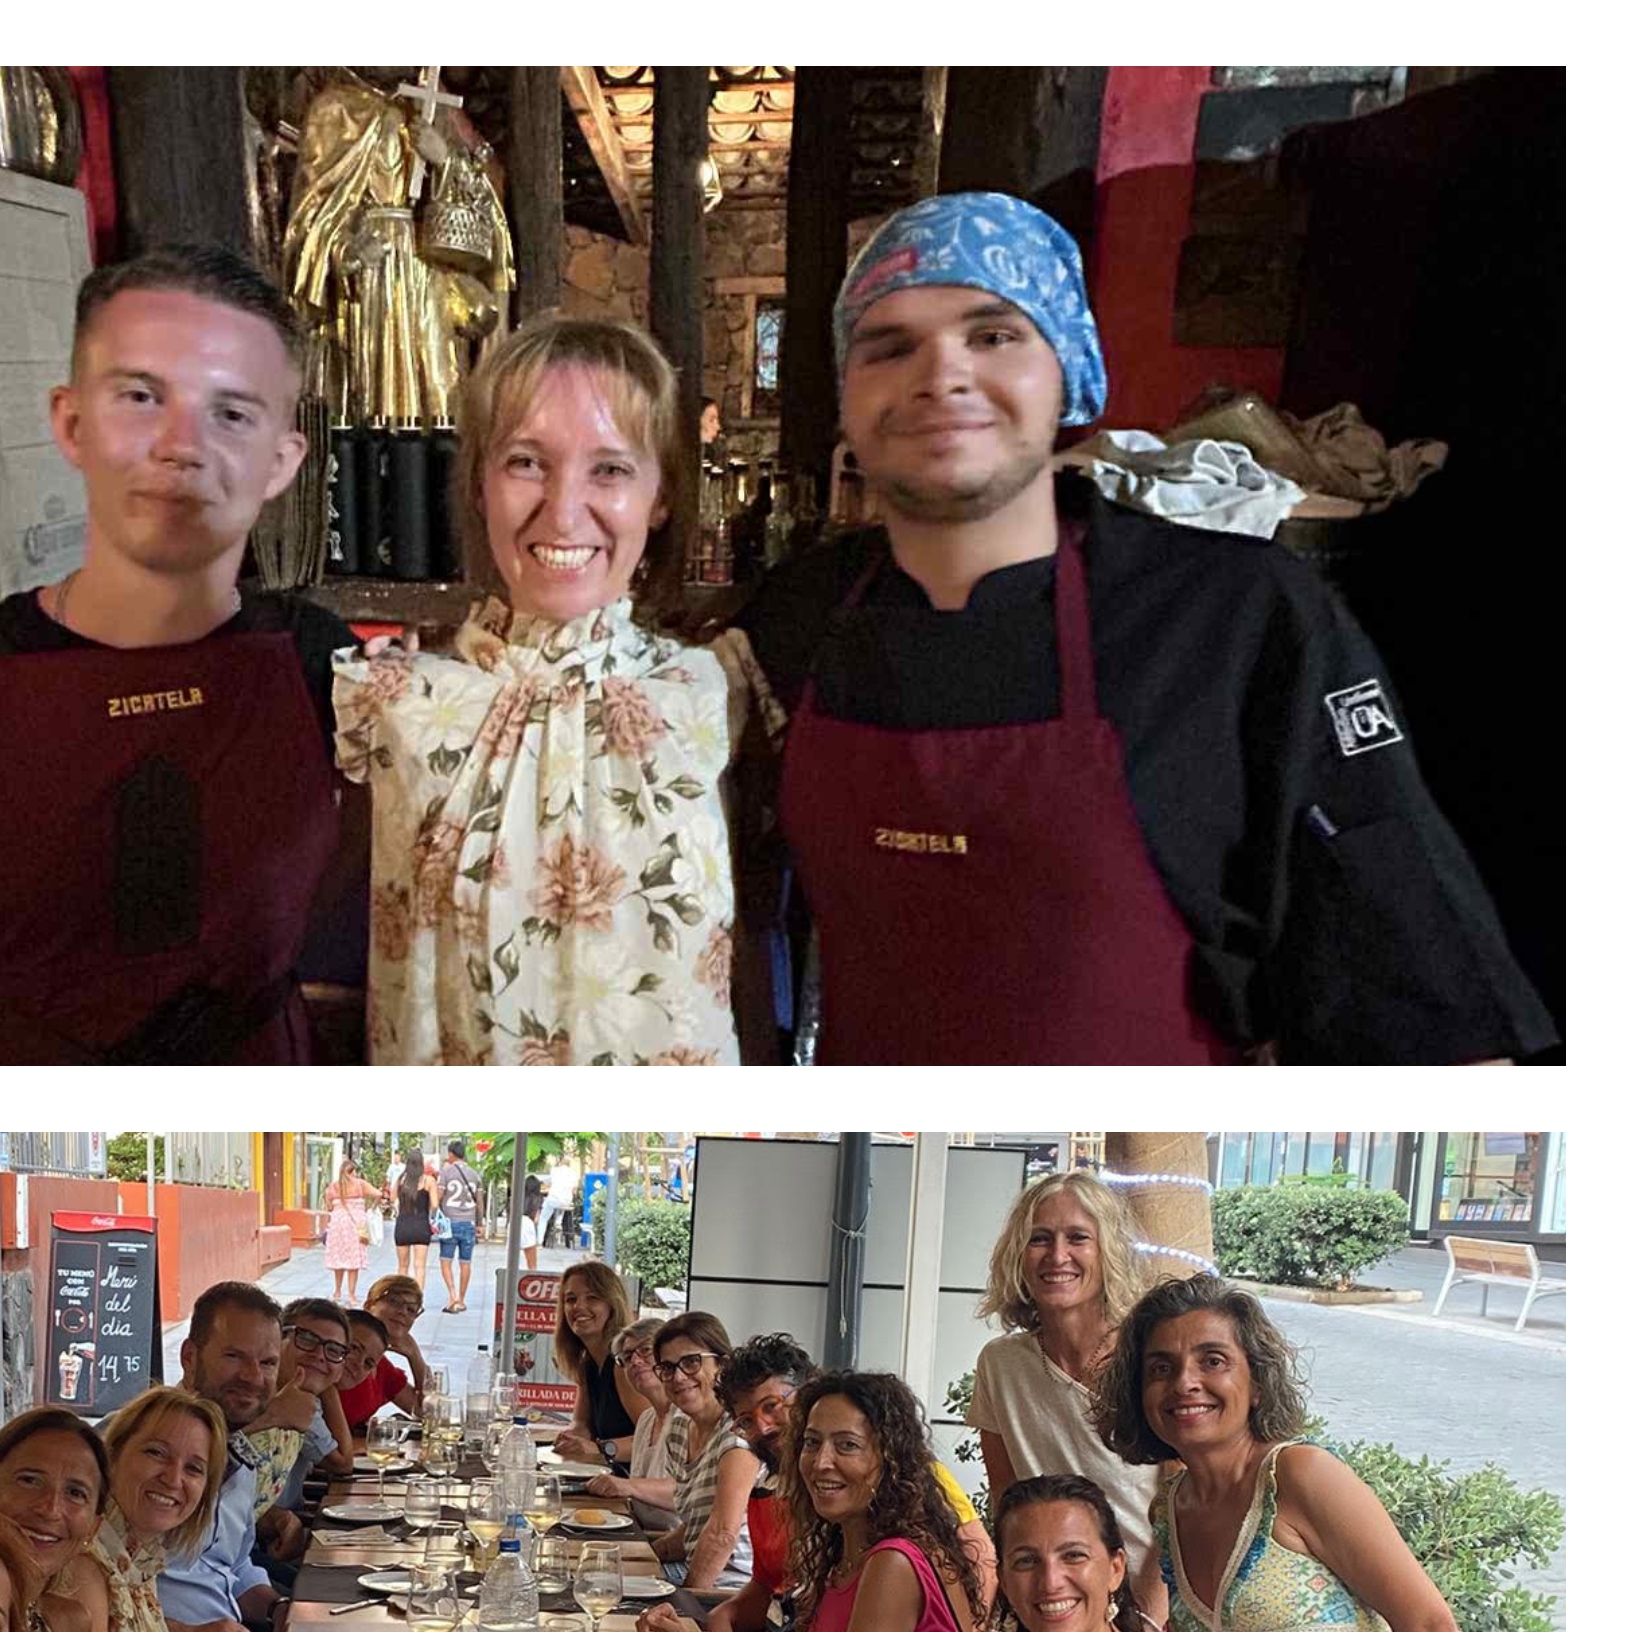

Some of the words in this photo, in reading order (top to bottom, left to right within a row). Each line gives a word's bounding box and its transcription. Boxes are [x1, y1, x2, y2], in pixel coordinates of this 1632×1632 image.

[107, 687, 204, 718] ZICATELA
[446, 1179, 476, 1208] 23
[525, 1280, 560, 1299] OFE
[105, 1293, 131, 1313] del
